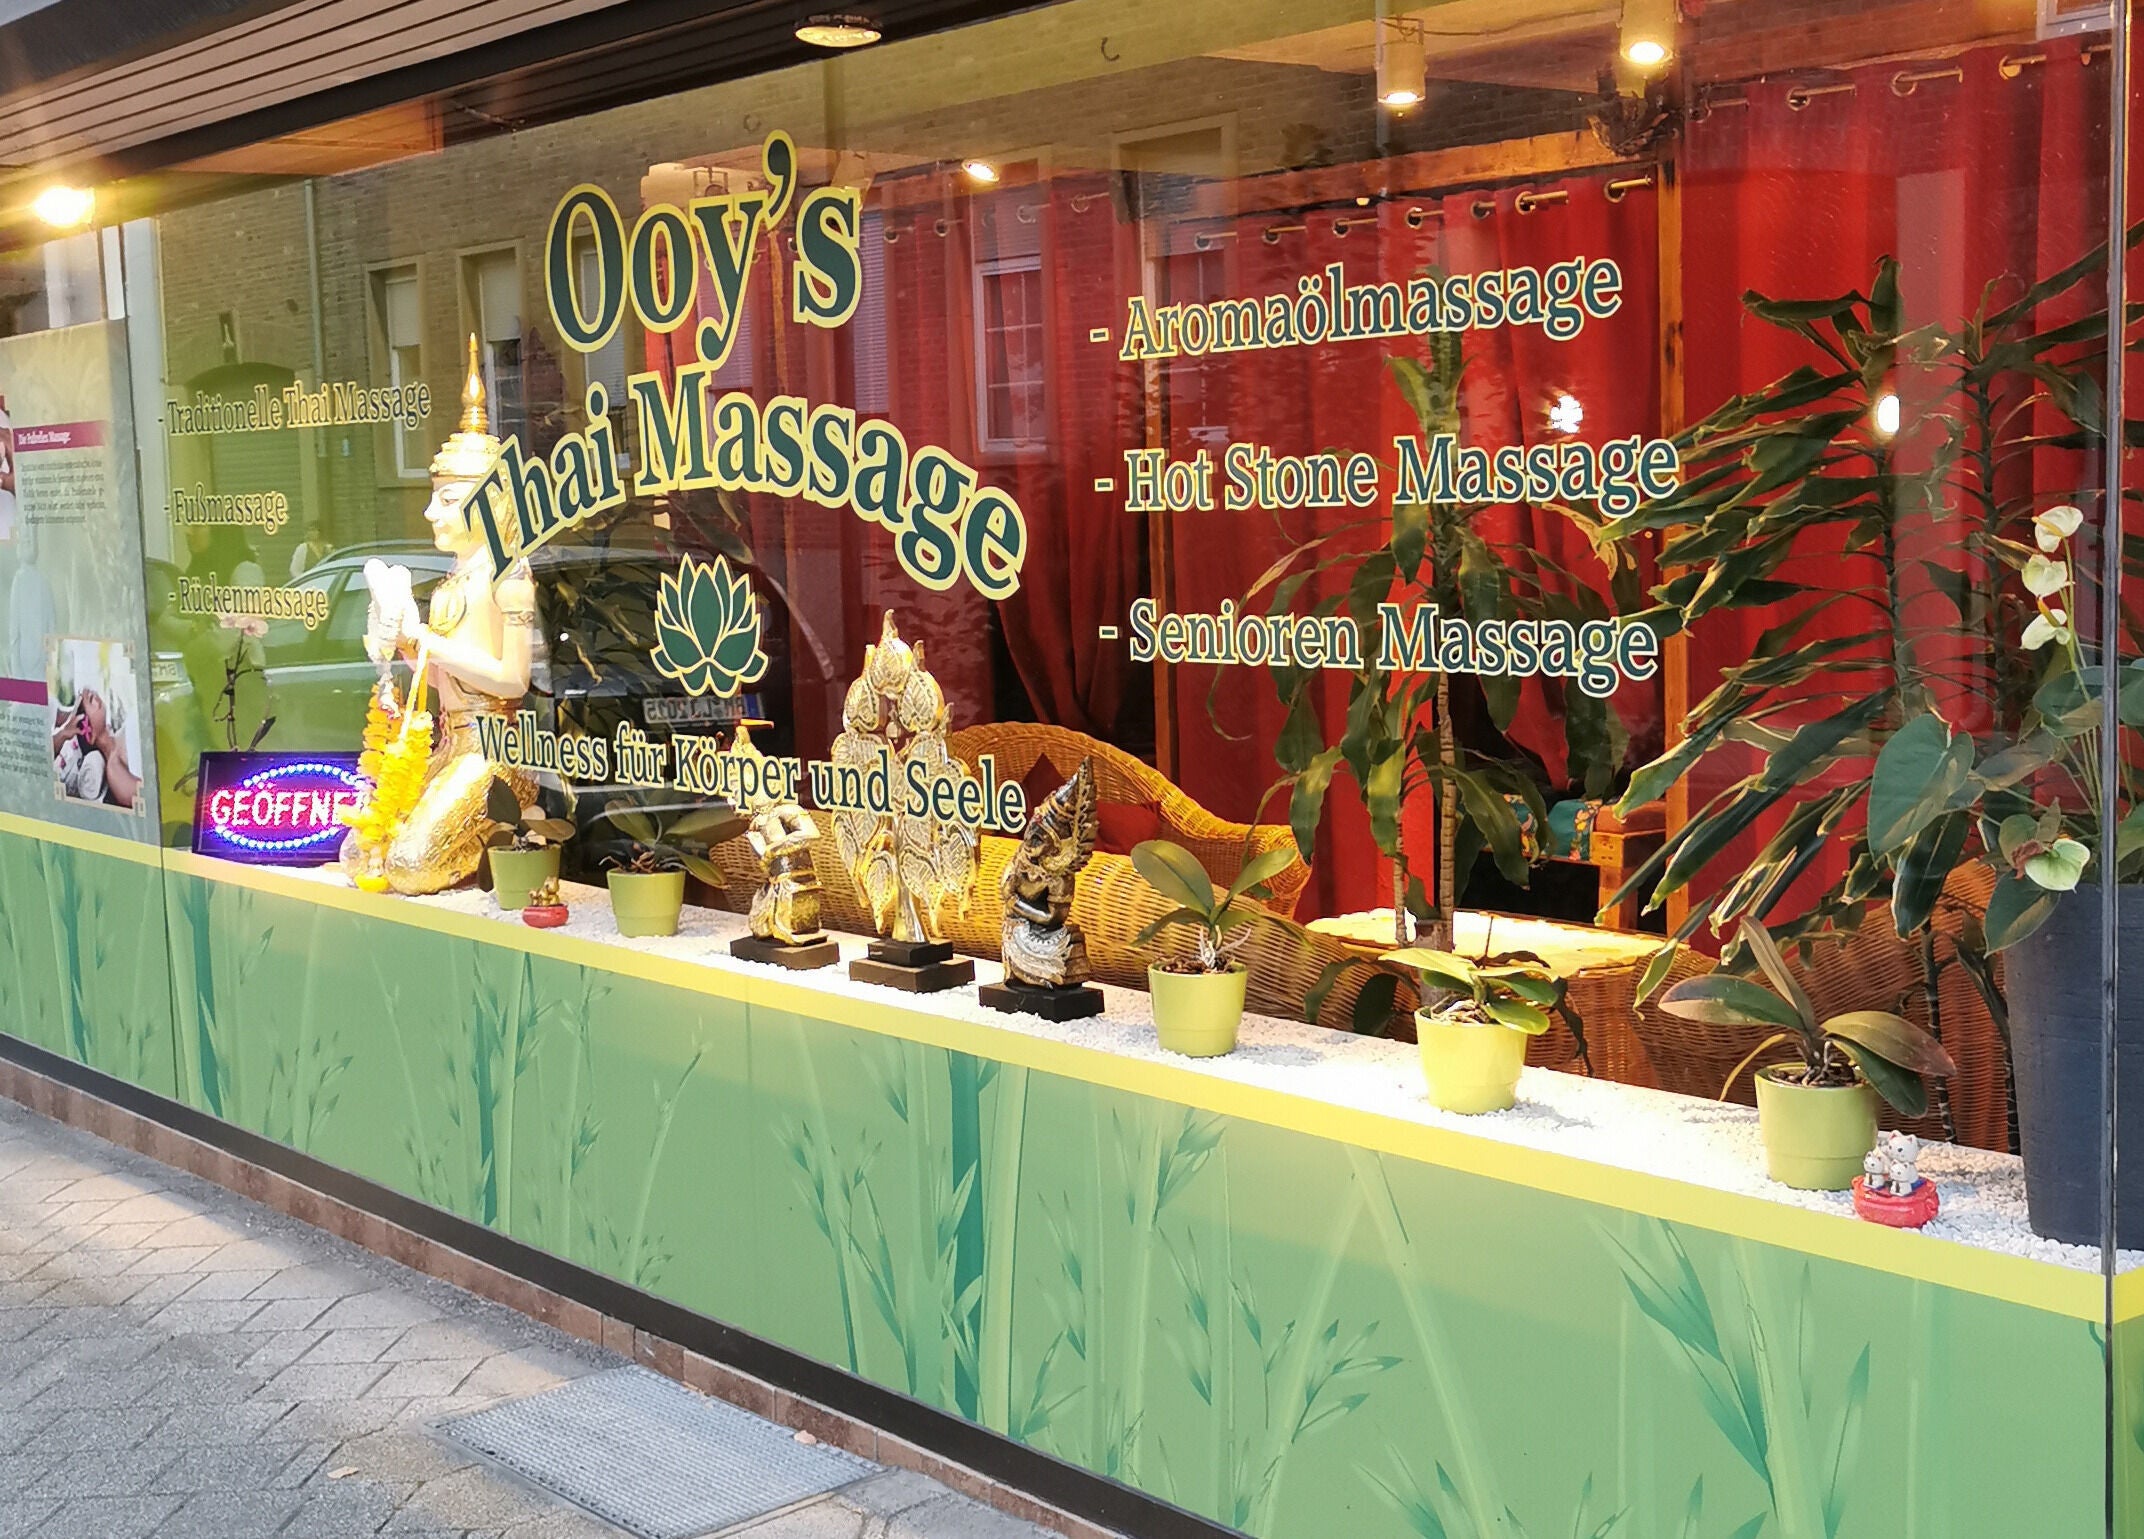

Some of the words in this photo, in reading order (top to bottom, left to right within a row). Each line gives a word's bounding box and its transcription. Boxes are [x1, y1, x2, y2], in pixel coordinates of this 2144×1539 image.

[545, 129, 863, 372] Ooy’s
[1119, 256, 1622, 361] Aromaölmassage
[167, 386, 282, 434] Traditionelle
[283, 380, 331, 428] Thai
[333, 381, 431, 430] Massage
[172, 482, 288, 535] Fußmassage
[460, 381, 626, 585] Thai
[628, 362, 1028, 601] Massage
[1125, 444, 1214, 512] Hot
[1225, 442, 1379, 510] Stone
[1394, 434, 1680, 516] Massage
[178, 572, 328, 631] Rückenmassage
[1129, 598, 1363, 670] Senioren
[1377, 602, 1658, 698] Massage
[476, 711, 608, 780] Wellness
[614, 720, 667, 788] für
[672, 733, 802, 814] Körper
[810, 748, 893, 817] und
[905, 753, 1028, 833] Seele
